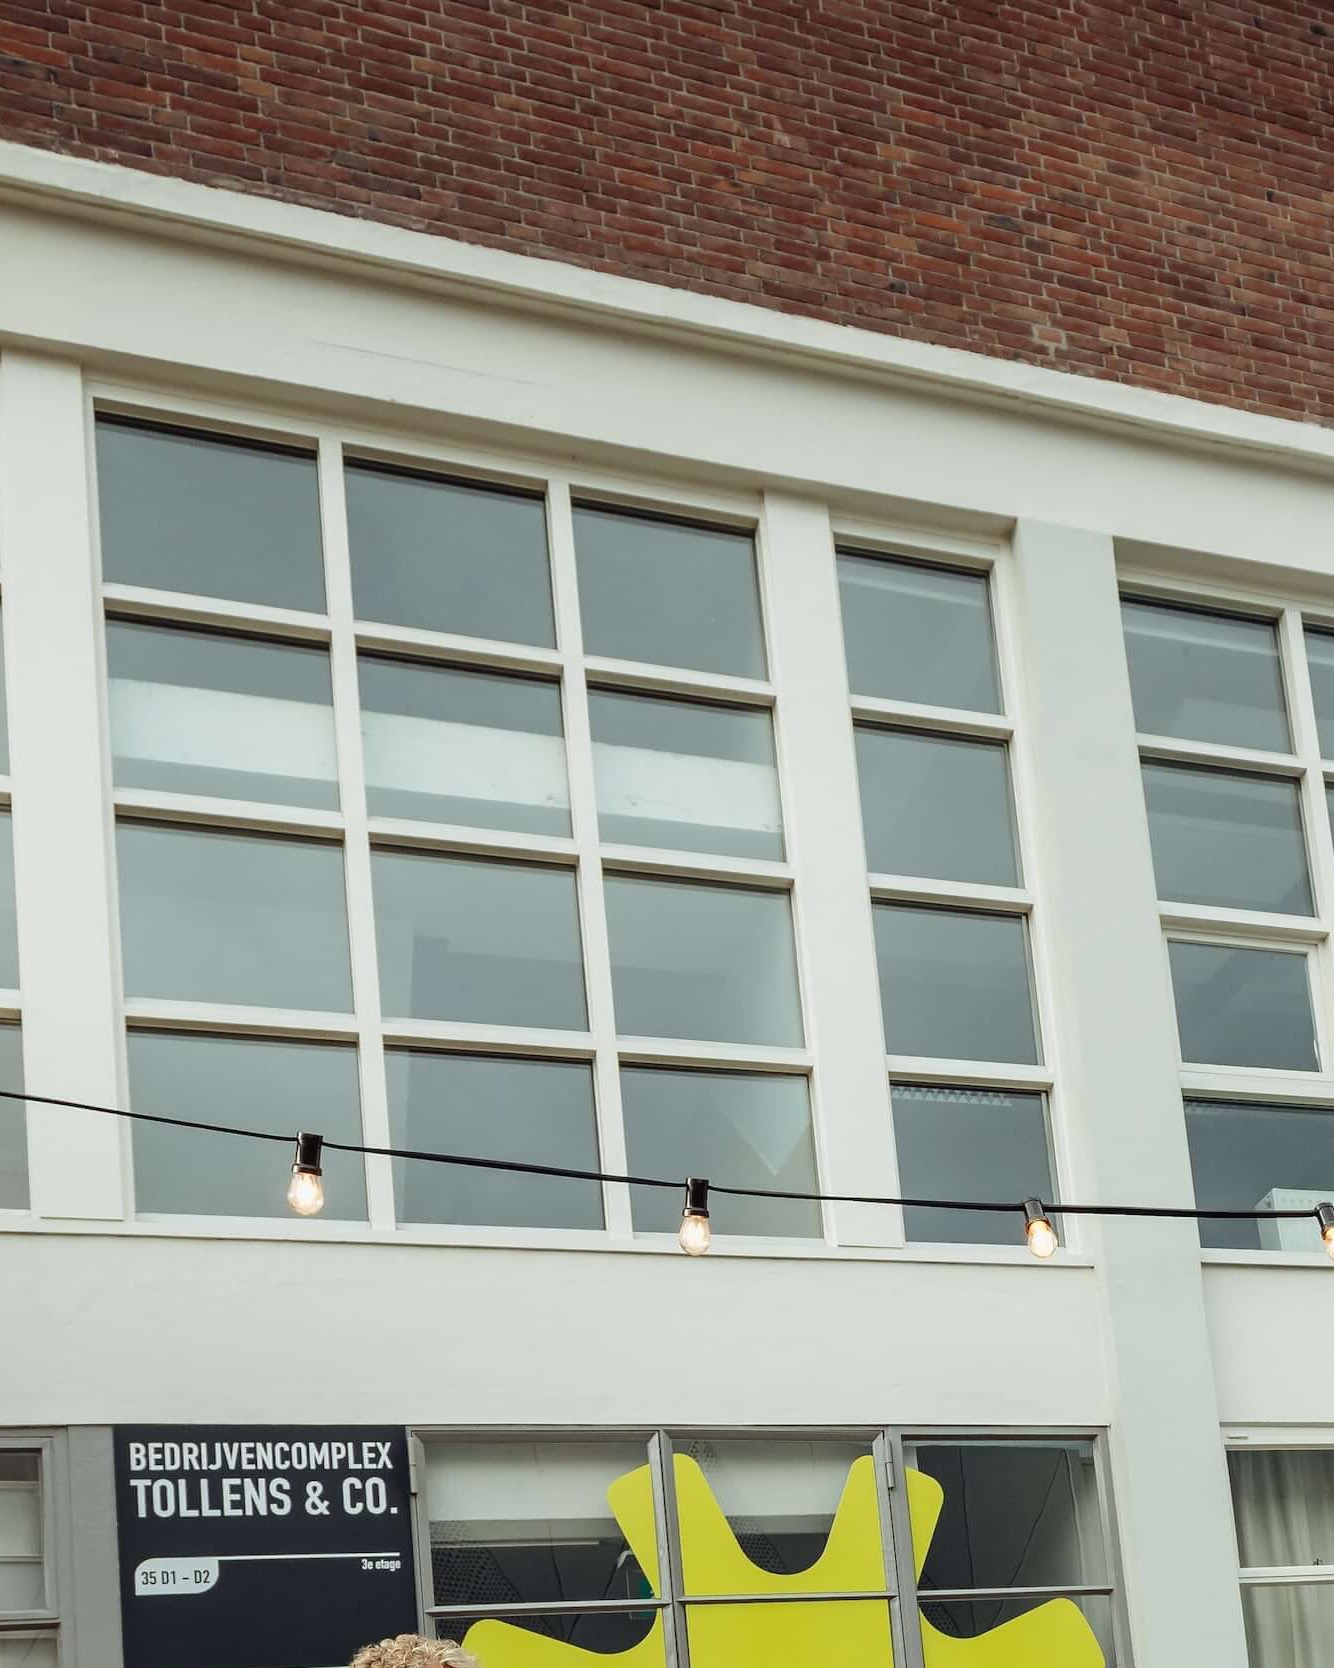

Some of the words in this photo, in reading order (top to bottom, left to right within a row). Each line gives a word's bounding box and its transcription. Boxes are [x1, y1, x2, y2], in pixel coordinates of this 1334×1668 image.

[129, 1442, 393, 1471] BEDRIJVENCOMPLEX
[129, 1477, 292, 1518] TOLLENS
[304, 1480, 331, 1515] &
[342, 1476, 398, 1514] CO.
[141, 1571, 157, 1585] 35
[161, 1570, 176, 1585] D1
[194, 1569, 211, 1584] D2
